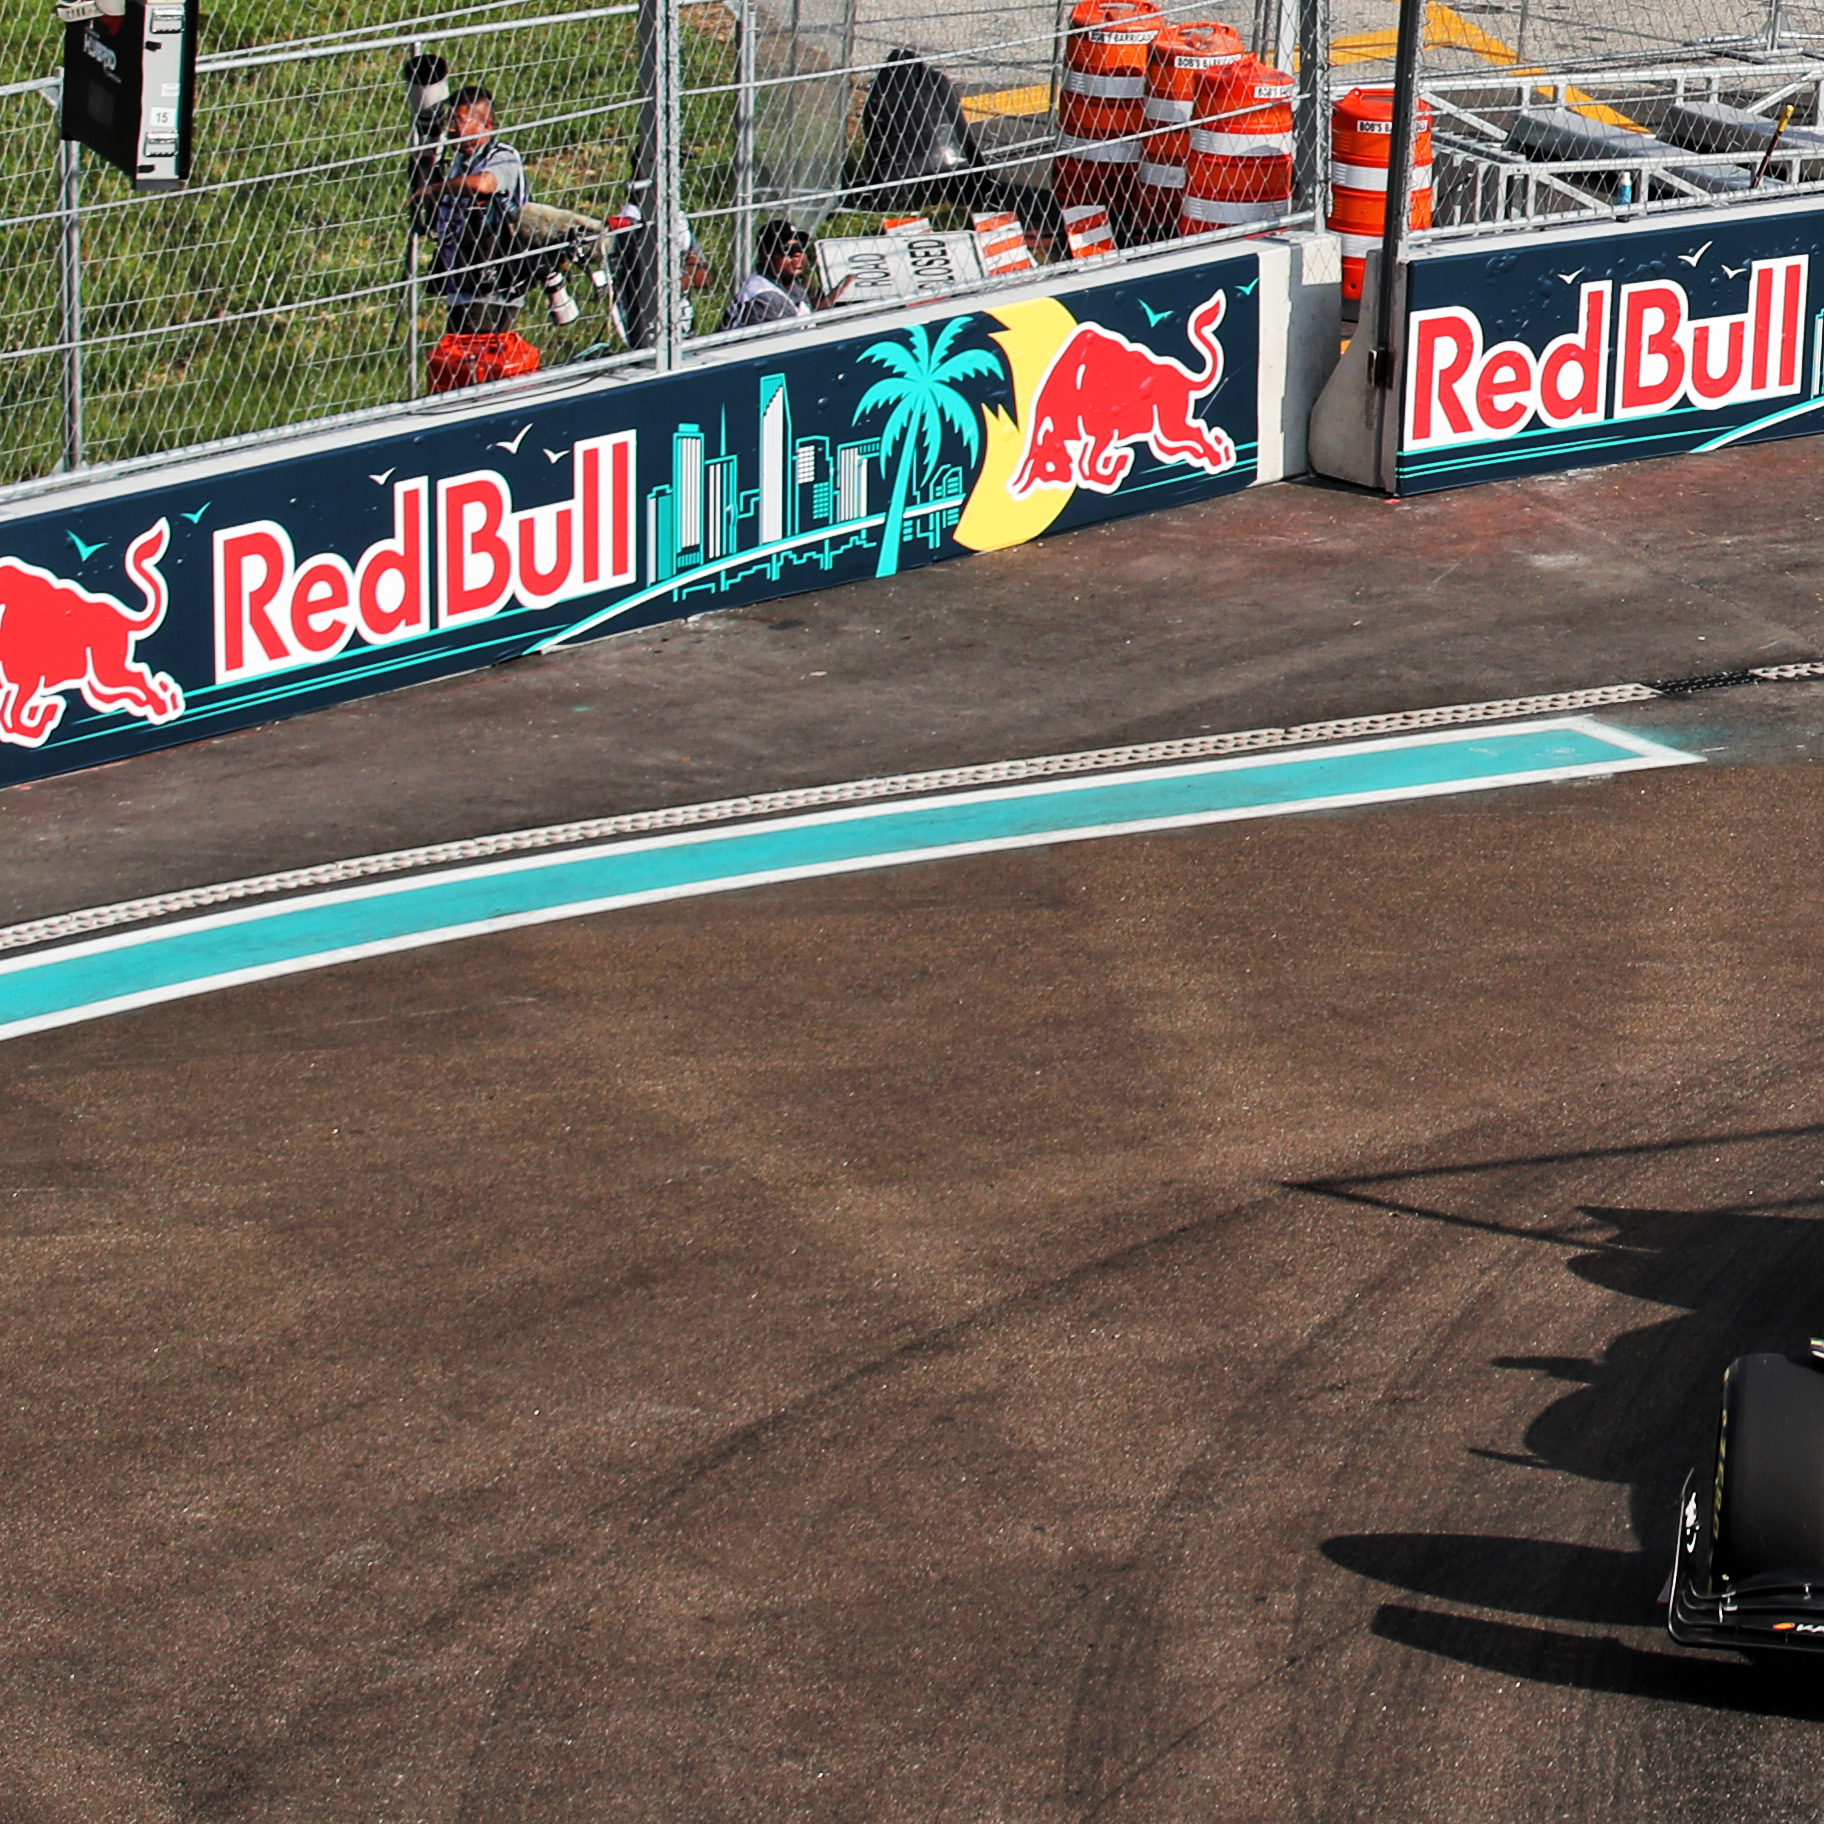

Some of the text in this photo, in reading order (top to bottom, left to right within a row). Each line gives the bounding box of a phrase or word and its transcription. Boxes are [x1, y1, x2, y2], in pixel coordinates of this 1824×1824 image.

[156, 112, 168, 123] 15
[1359, 121, 1383, 132] BOB'S
[848, 253, 892, 287] ROAD
[1405, 255, 1807, 453] Red Bull
[213, 431, 637, 685] Red Bull
